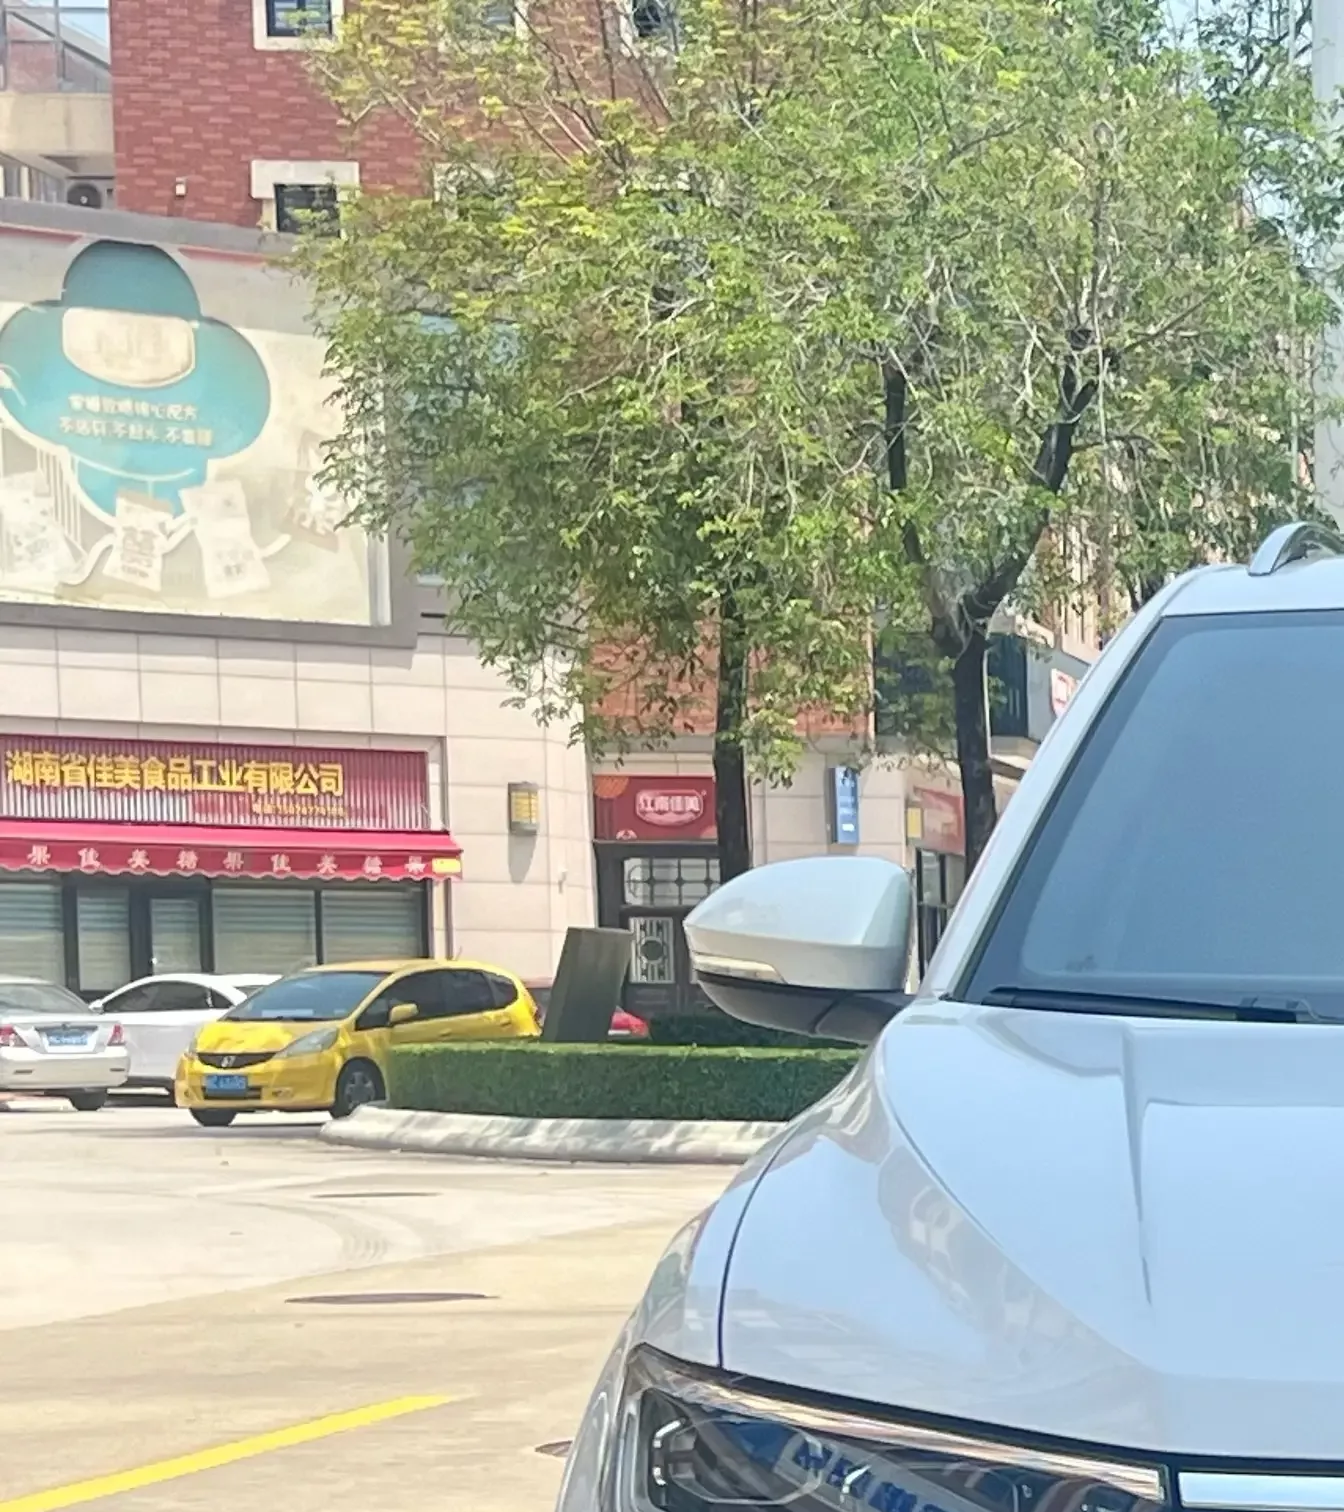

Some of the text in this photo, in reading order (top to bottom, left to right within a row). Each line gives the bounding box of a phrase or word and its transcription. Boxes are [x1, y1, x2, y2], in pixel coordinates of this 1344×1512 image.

[6, 750, 344, 797] 湖南省佳美食品工业有限公司
